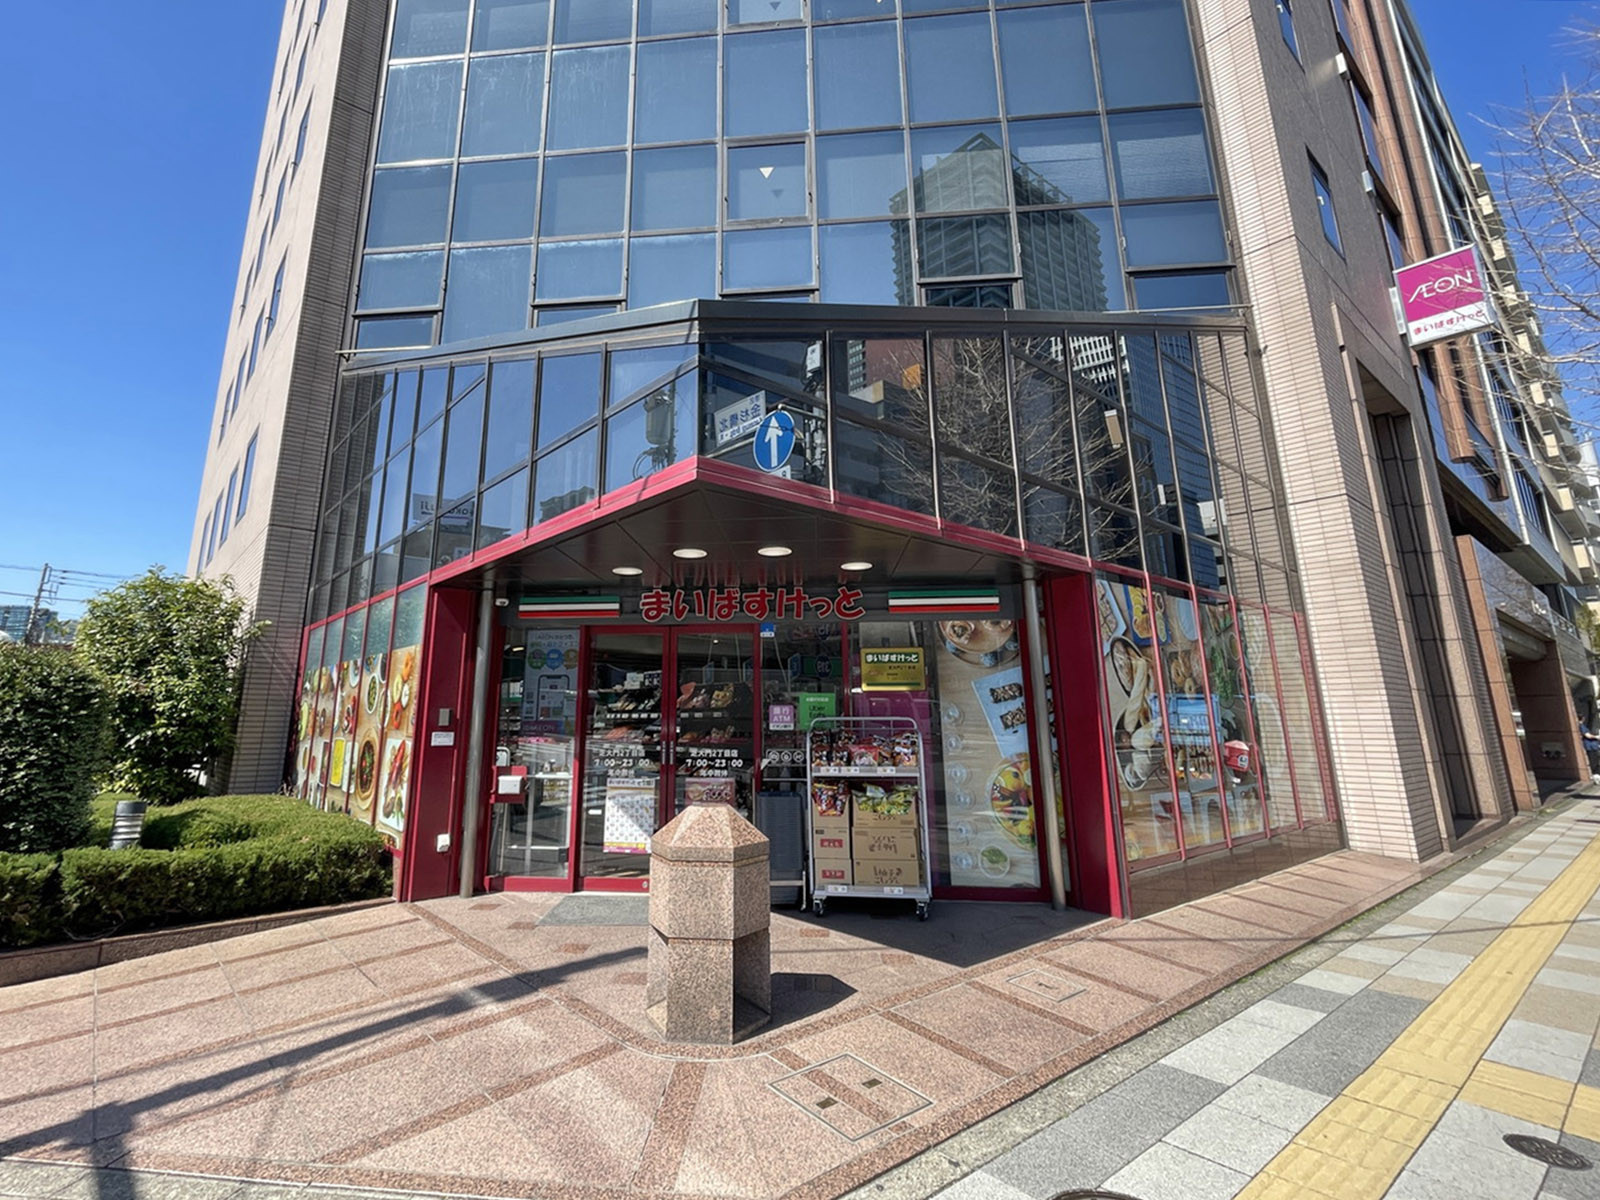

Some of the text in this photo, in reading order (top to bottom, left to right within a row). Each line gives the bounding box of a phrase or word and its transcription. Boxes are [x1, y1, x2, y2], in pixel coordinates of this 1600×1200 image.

[1413, 309, 1486, 335] まいばすけっと
[640, 587, 866, 622] まいばすけっと
[865, 653, 919, 663] まいばすけっと
